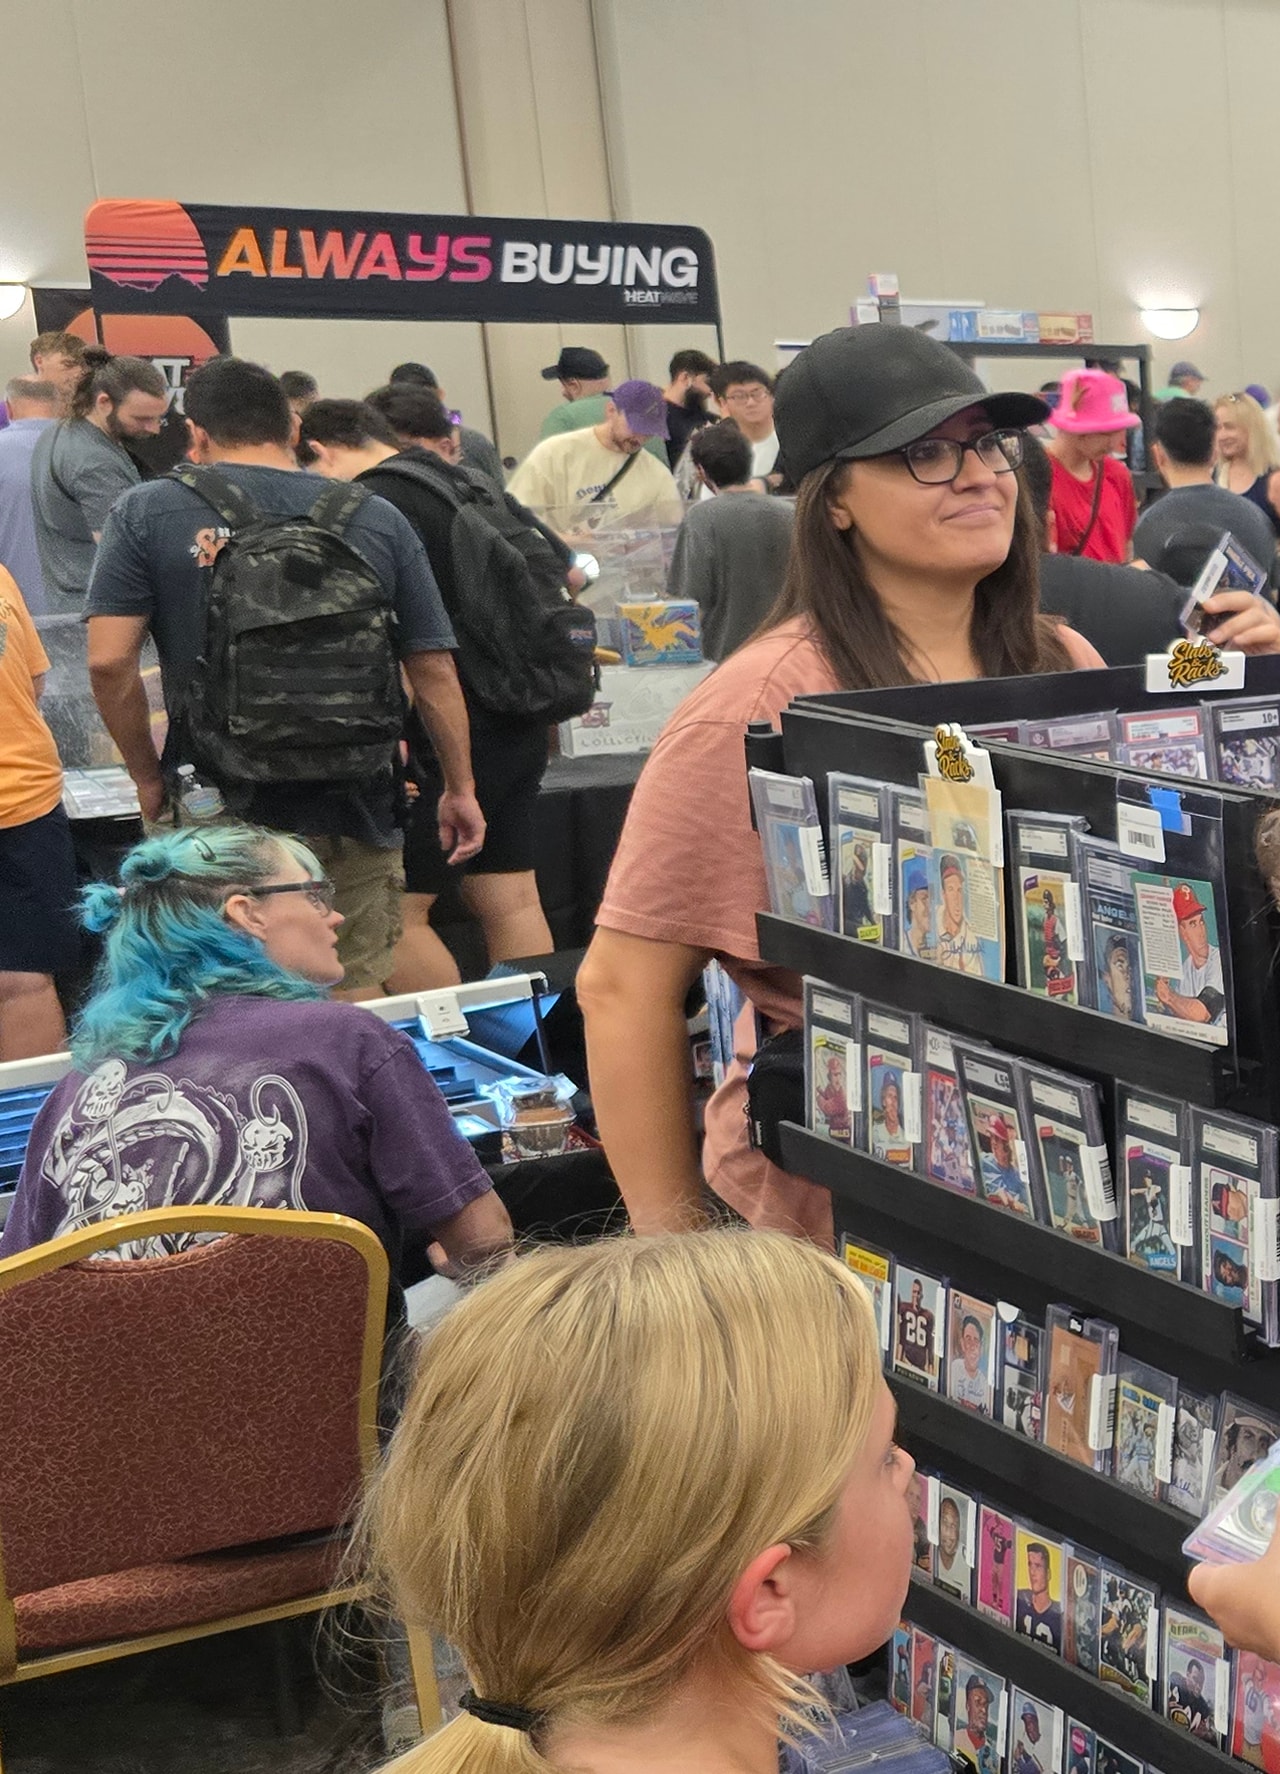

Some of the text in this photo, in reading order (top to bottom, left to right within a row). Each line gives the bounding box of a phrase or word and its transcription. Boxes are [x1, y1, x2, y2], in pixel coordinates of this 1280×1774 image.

[217, 227, 699, 288] ALWAYS BUYING
[1168, 638, 1218, 667] Slabs
[1170, 657, 1227, 688] Racks
[905, 1311, 927, 1347] 26
